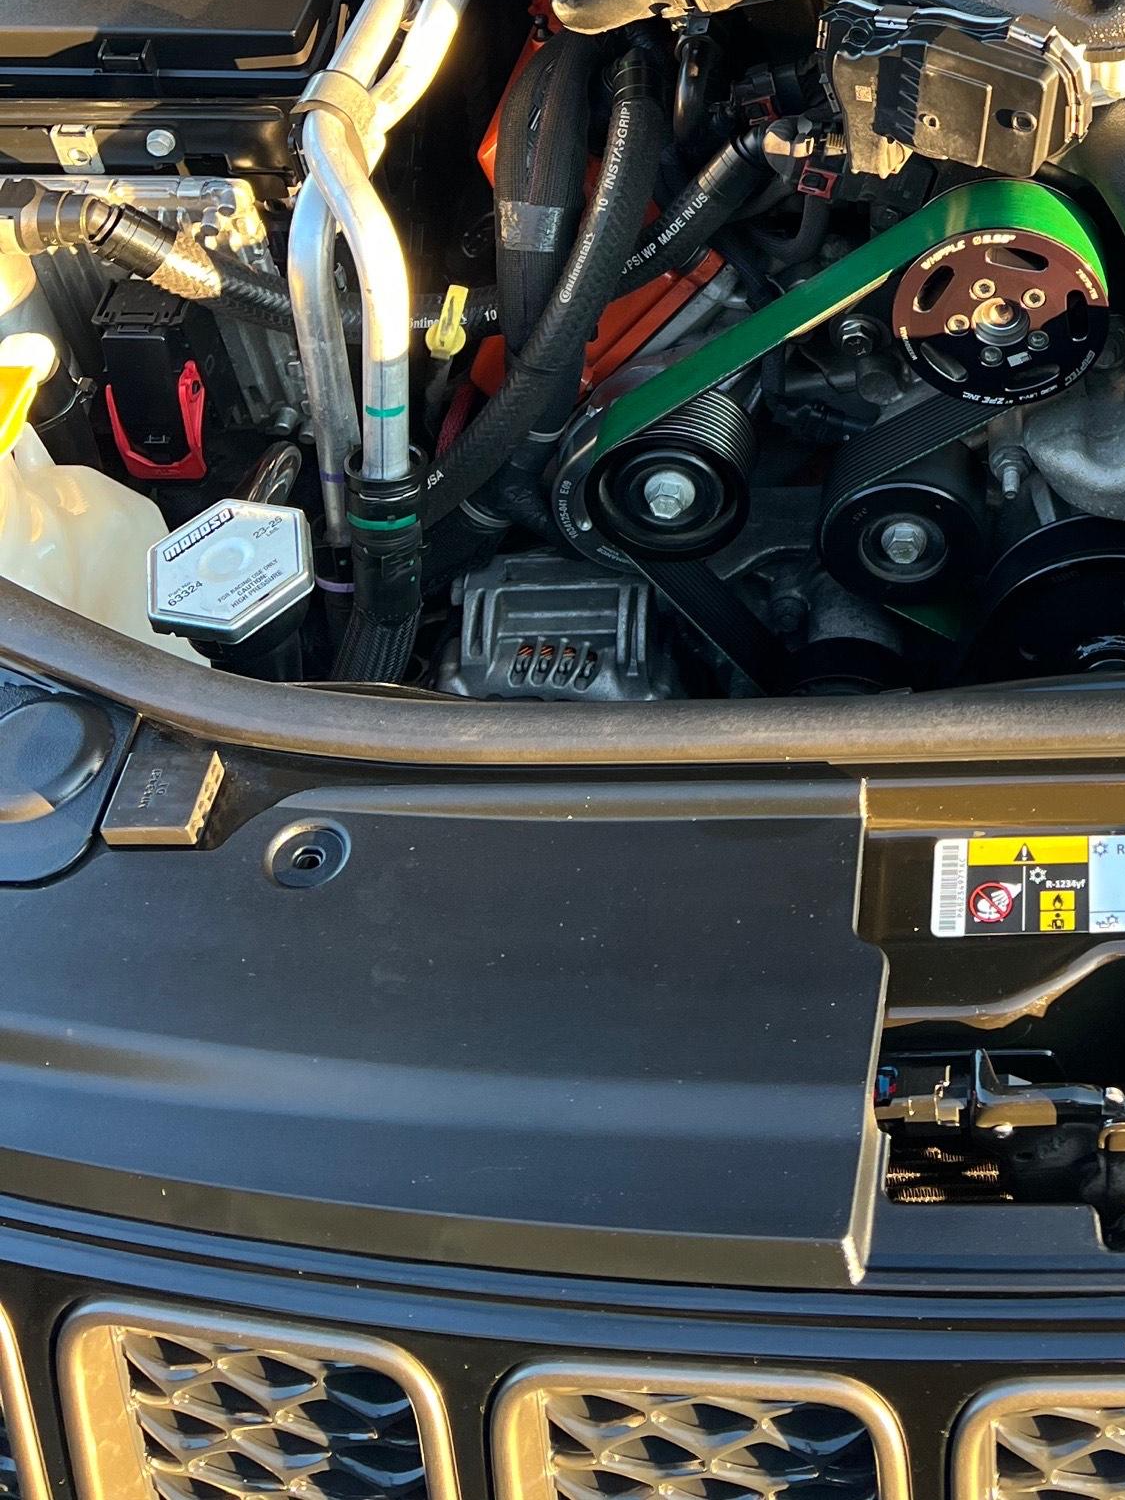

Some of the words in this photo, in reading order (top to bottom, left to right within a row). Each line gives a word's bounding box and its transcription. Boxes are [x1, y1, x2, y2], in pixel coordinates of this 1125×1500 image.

[597, 198, 608, 212] 10
[627, 256, 644, 270] PSI
[641, 242, 656, 262] WP
[658, 216, 686, 246] MADE
[683, 206, 696, 222] IN
[692, 192, 711, 209] US
[484, 309, 498, 322] 10
[163, 508, 235, 562] MOROSO
[168, 580, 204, 607] 63324
[231, 594, 249, 608] HIGH
[247, 569, 284, 597] PRESSURE
[1045, 878, 1086, 889] R-1234yf
